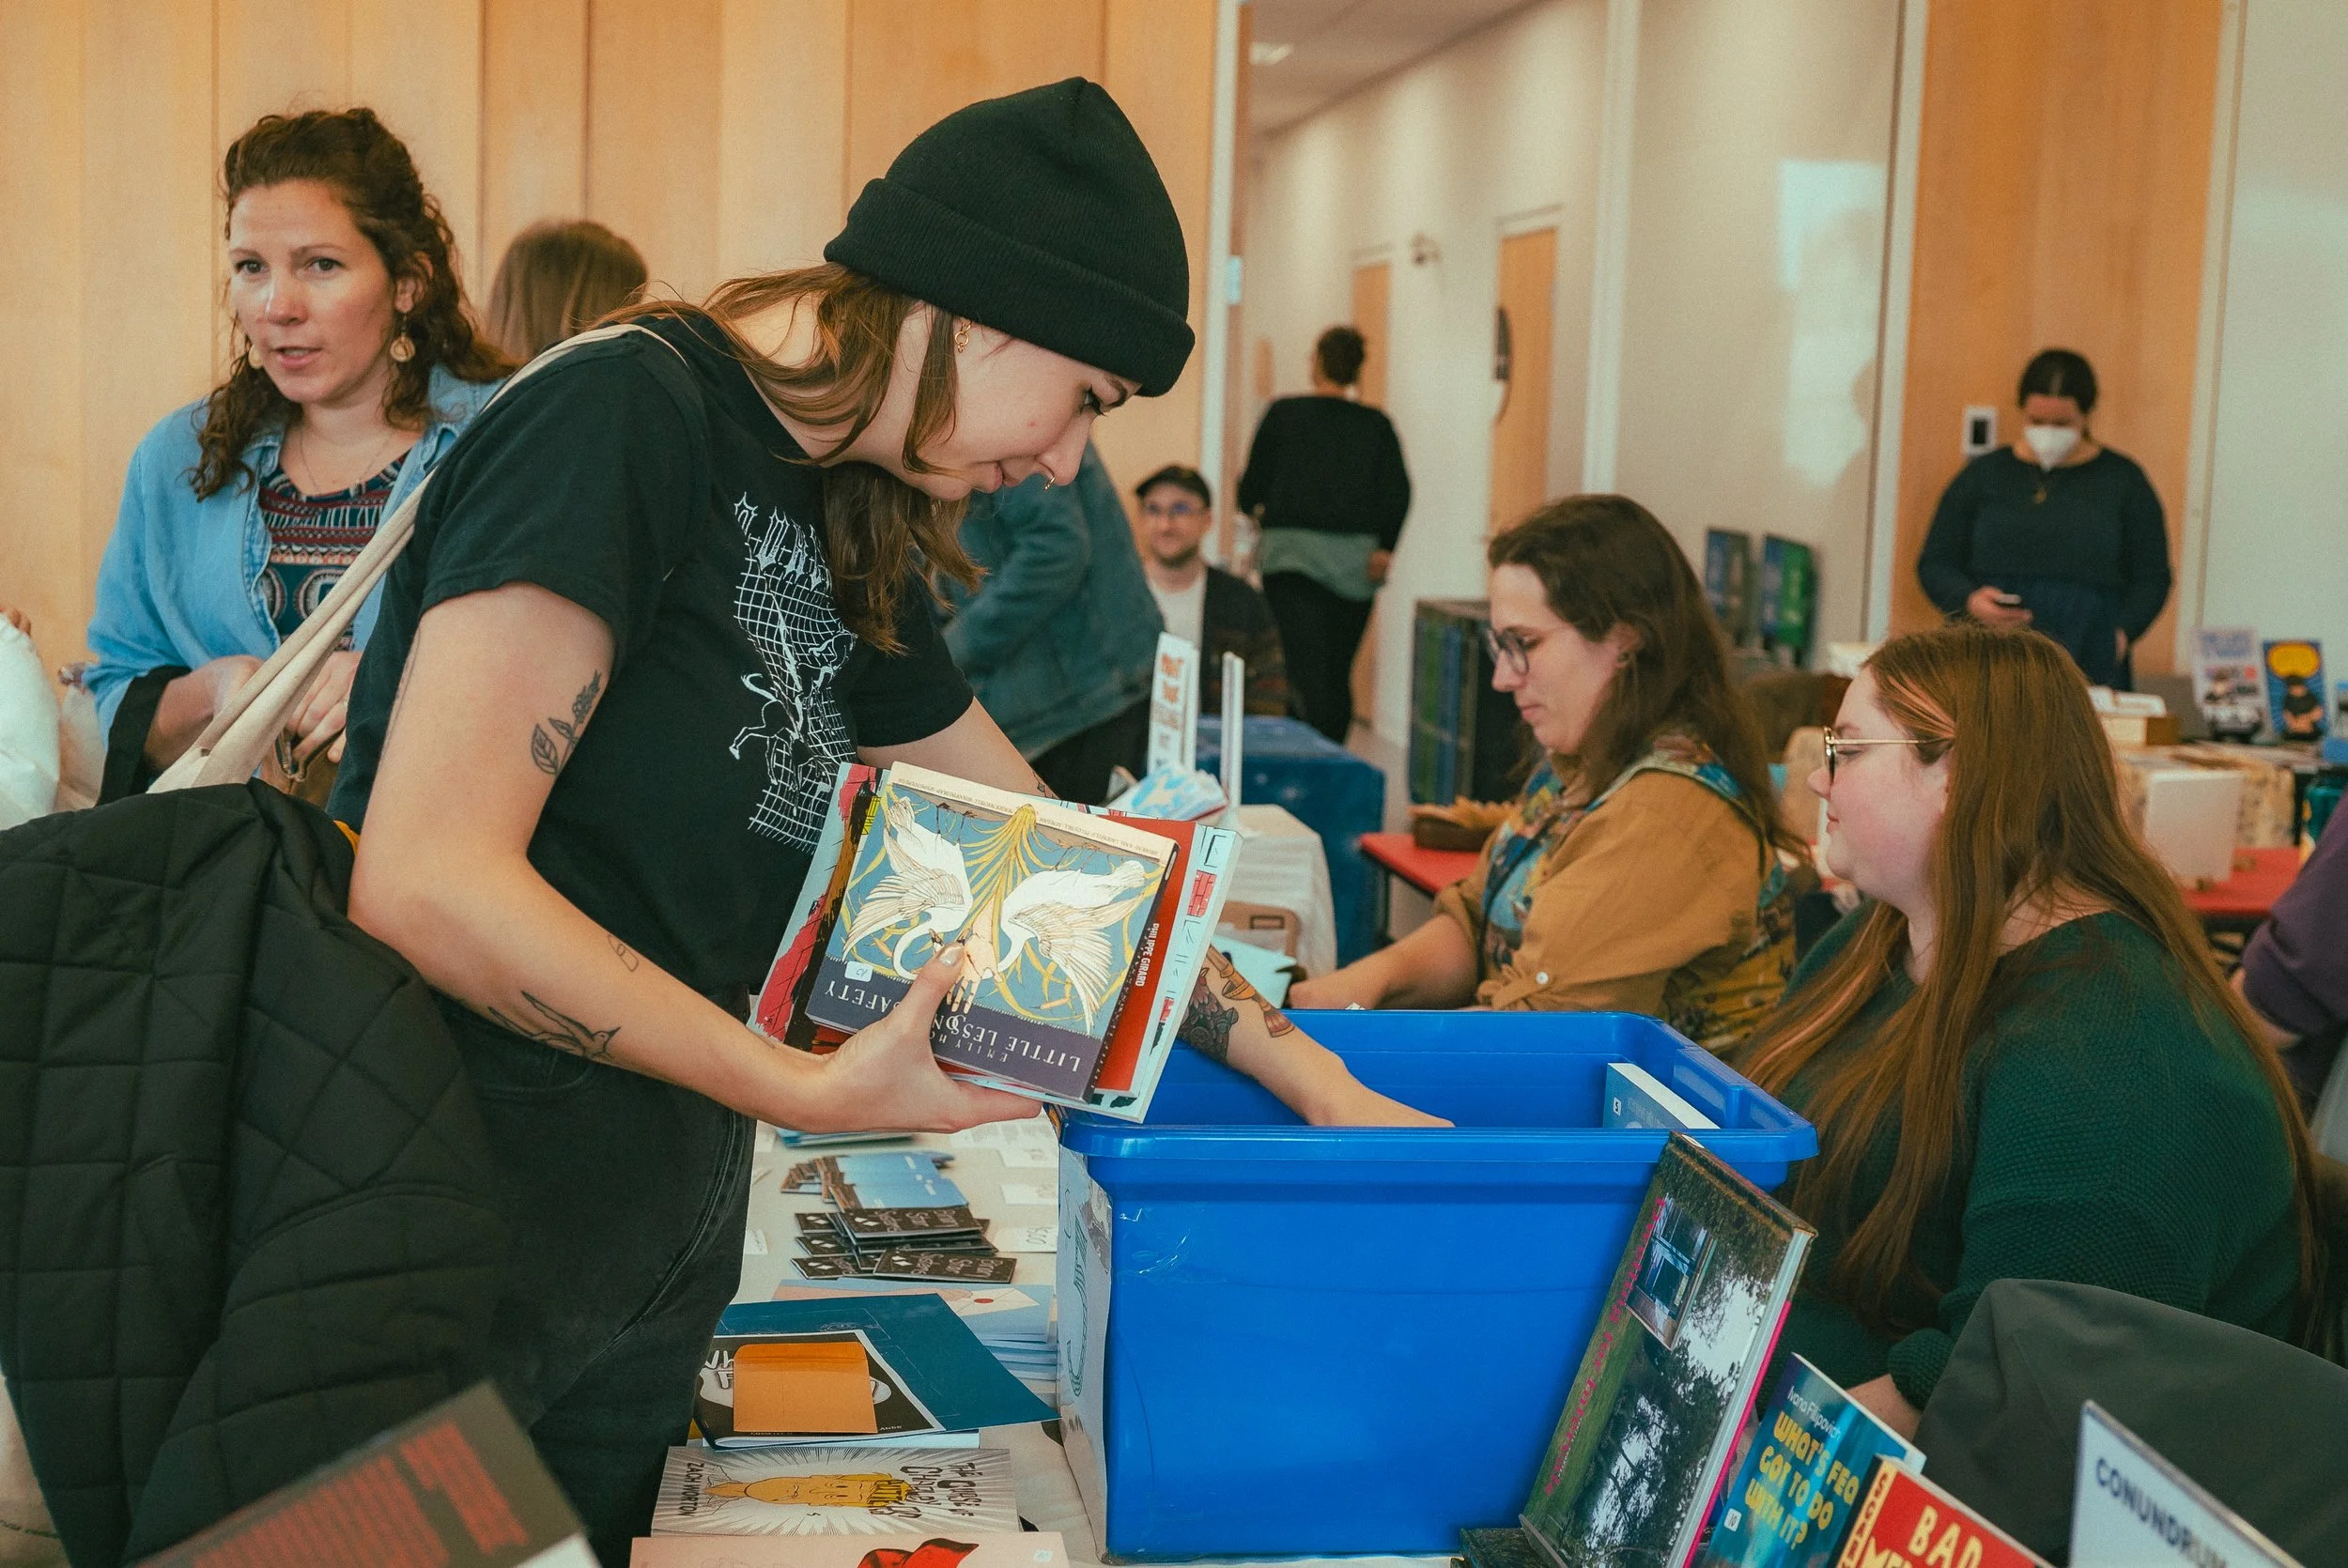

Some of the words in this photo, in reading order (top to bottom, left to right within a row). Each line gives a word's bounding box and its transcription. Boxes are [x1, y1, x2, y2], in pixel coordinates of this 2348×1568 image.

[1142, 923, 1160, 956] PHILIPPE
[1135, 958, 1151, 987] GIRARD
[933, 1013, 998, 1046] LESSON
[955, 1039, 1009, 1063] EMILY
[1005, 1036, 1081, 1072] LITTLE
[1608, 1196, 1665, 1324] Dwelling
[1594, 1330, 1614, 1374] for
[685, 1462, 704, 1483] ZACH
[948, 1462, 983, 1478] THE
[1773, 1411, 1831, 1478] WHAT'S
[1826, 1460, 1861, 1505] FEA
[678, 1484, 701, 1517] WORTON
[937, 1479, 982, 1507] CURSE
[1758, 1445, 1792, 1489] GOT
[1787, 1470, 1811, 1508] TO
[1807, 1490, 1834, 1530] DO
[1745, 1478, 1784, 1531] WITH
[1780, 1513, 1809, 1550] IT?
[1908, 1504, 1984, 1568] BAD
